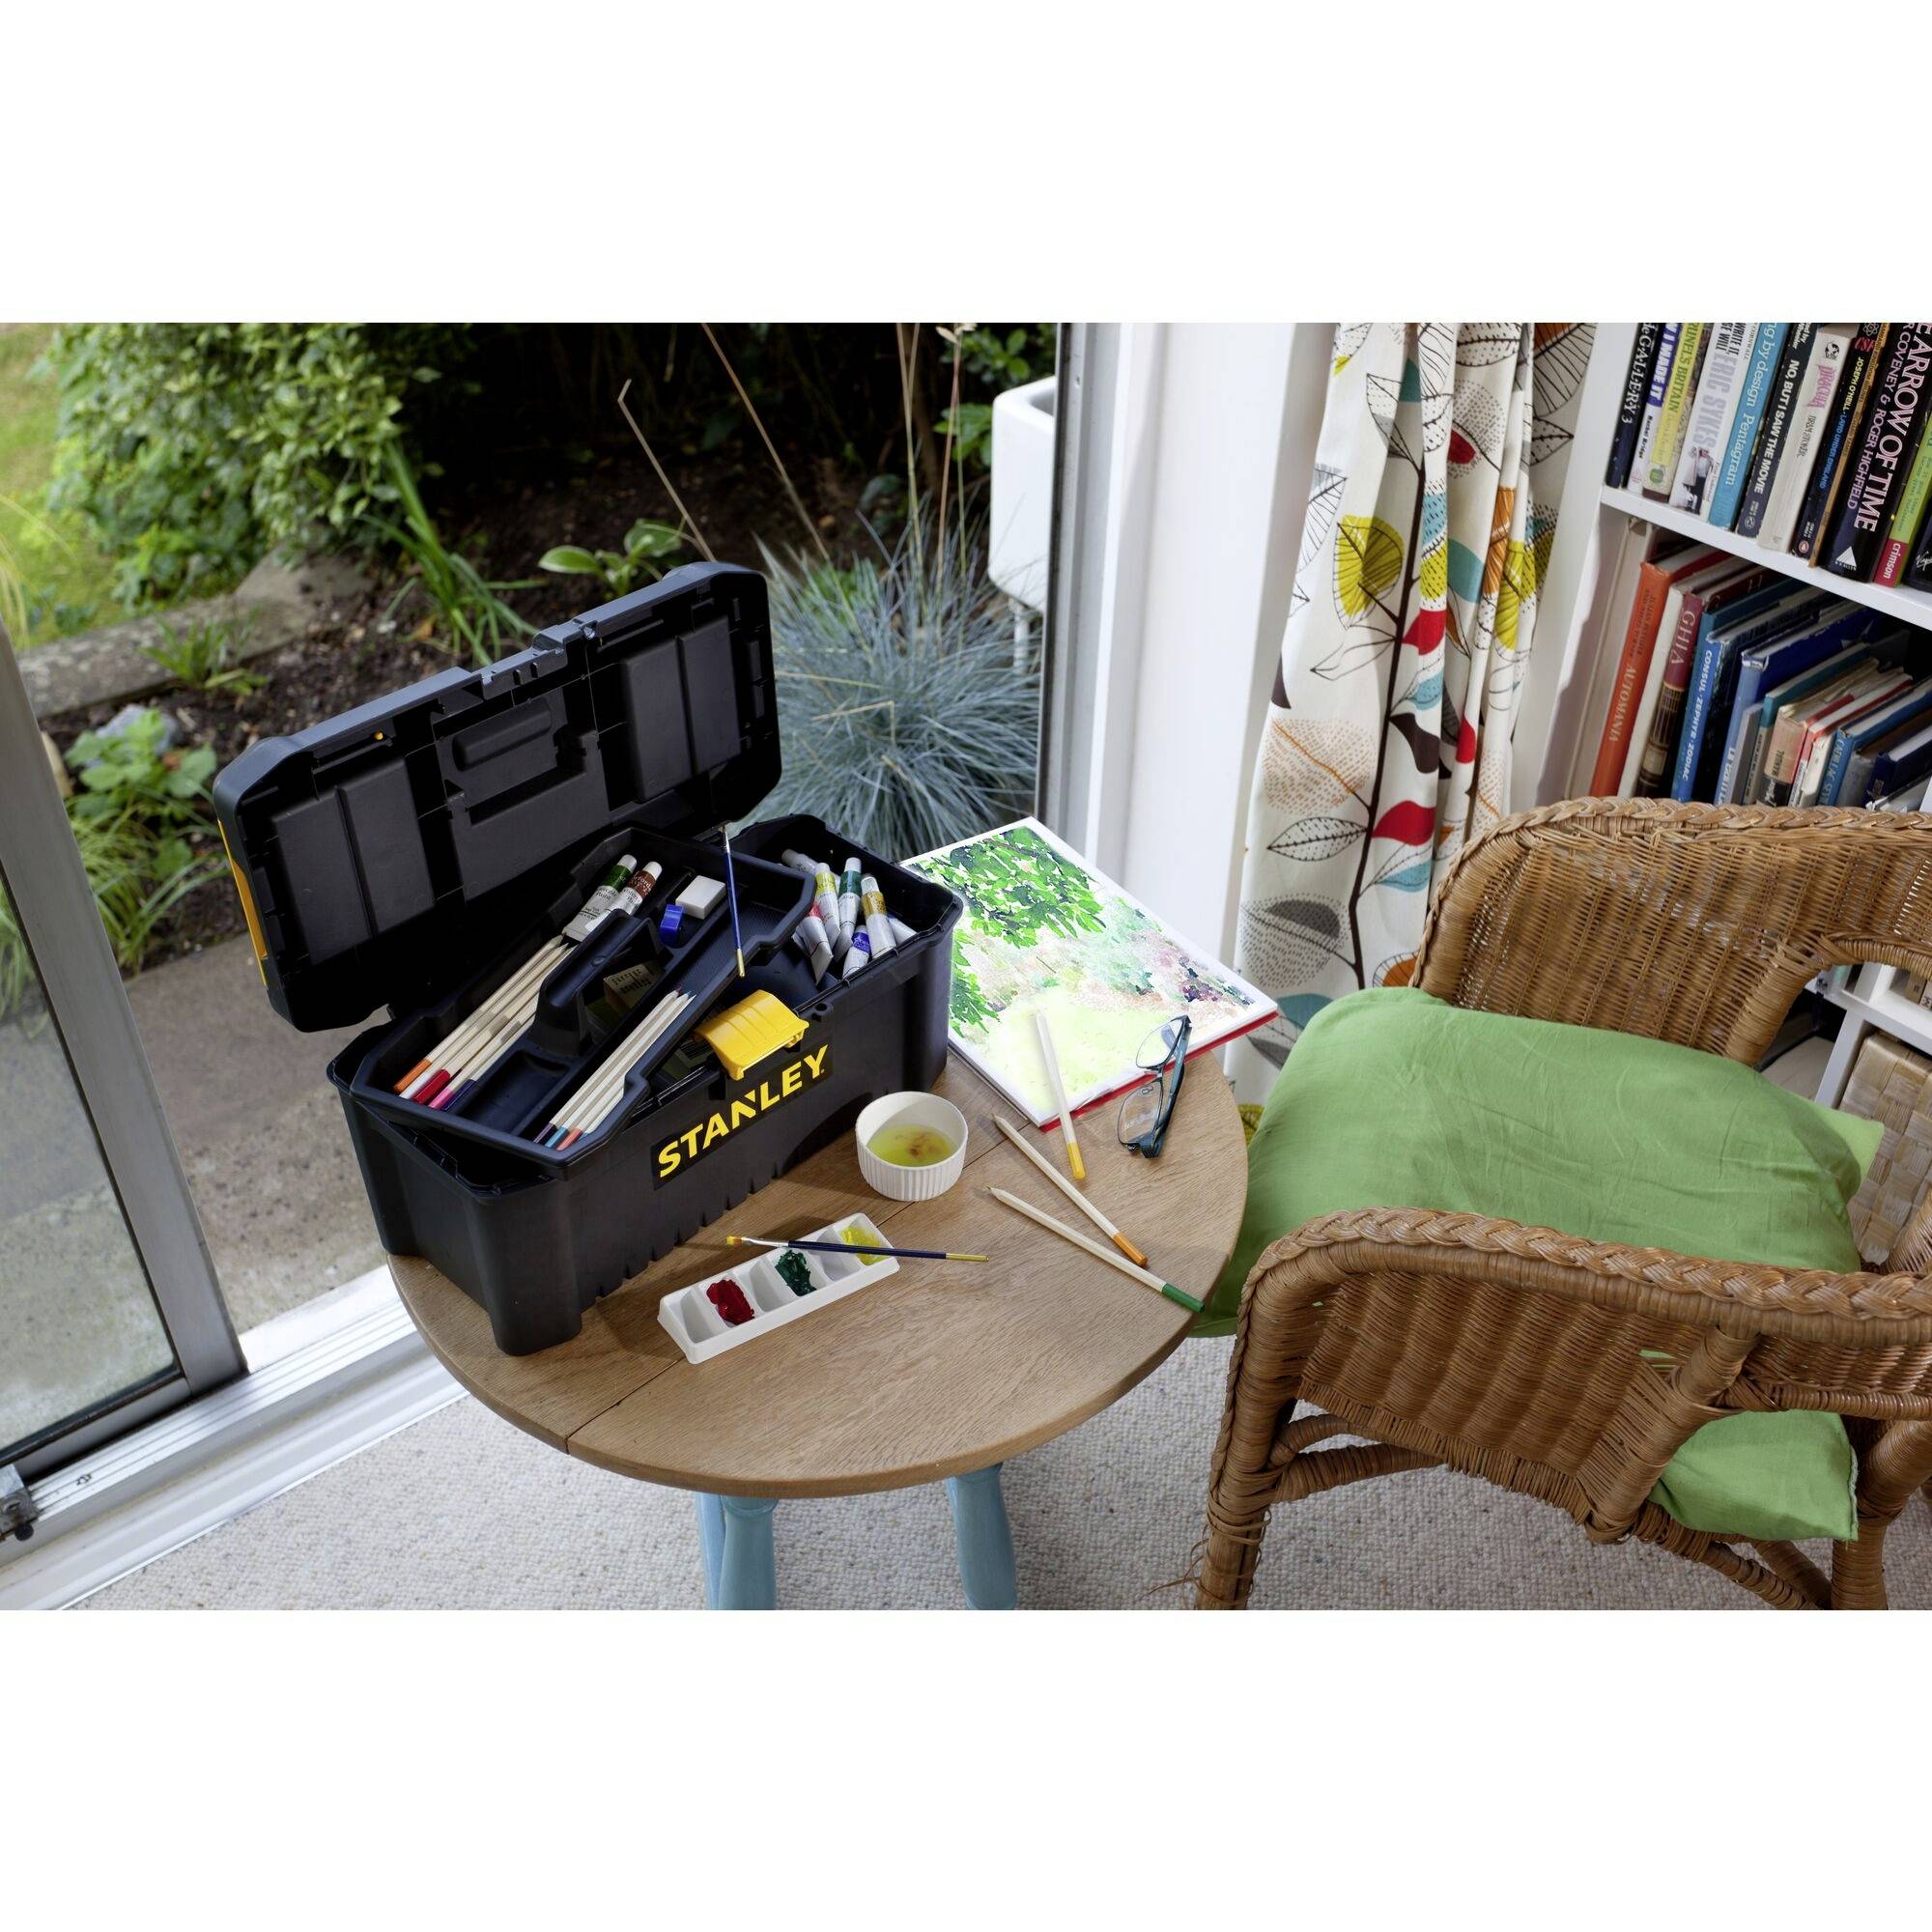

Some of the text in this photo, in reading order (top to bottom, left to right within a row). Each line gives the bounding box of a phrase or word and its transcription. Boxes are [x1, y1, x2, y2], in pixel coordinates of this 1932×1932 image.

[1662, 333, 1676, 342] I
[1716, 332, 1731, 352] WILL
[1730, 323, 1746, 346] WRITE
[1758, 341, 1776, 359] by
[1801, 333, 1809, 343] by
[1653, 342, 1673, 384] MADE
[1785, 359, 1800, 379] NO,
[1851, 356, 1864, 385] JOSEPH
[1885, 331, 1911, 392] COVENEY
[1649, 384, 1663, 400] IT
[1668, 366, 1689, 412] BRITAIN
[1692, 353, 1738, 447] ERIC SYKES
[1746, 360, 1768, 407] design
[1779, 381, 1794, 406] BUT
[1808, 365, 1835, 408] DRACULA
[1880, 394, 1890, 405] &
[1888, 335, 1932, 436] ARROW
[1770, 411, 1785, 438] SAW
[1838, 414, 1847, 434] LAND
[1864, 408, 1887, 447] ROGER
[1725, 412, 1755, 486] Pentagram
[1764, 438, 1778, 457] THE
[1829, 434, 1841, 458] UNDER
[1875, 435, 1902, 470] OF
[1753, 460, 1772, 495] MOVIE
[1820, 458, 1834, 489] ENGLAND
[1847, 449, 1873, 509] HIGHFIELD
[1854, 472, 1892, 532] TIME
[1883, 543, 1901, 579] crimson
[1670, 610, 1695, 666] GHIA
[1608, 667, 1637, 742] AUTOMANIA
[1682, 649, 1713, 781] CONSUL ZEPHYR ZODIAC
[658, 1044, 828, 1178] STANLEY
